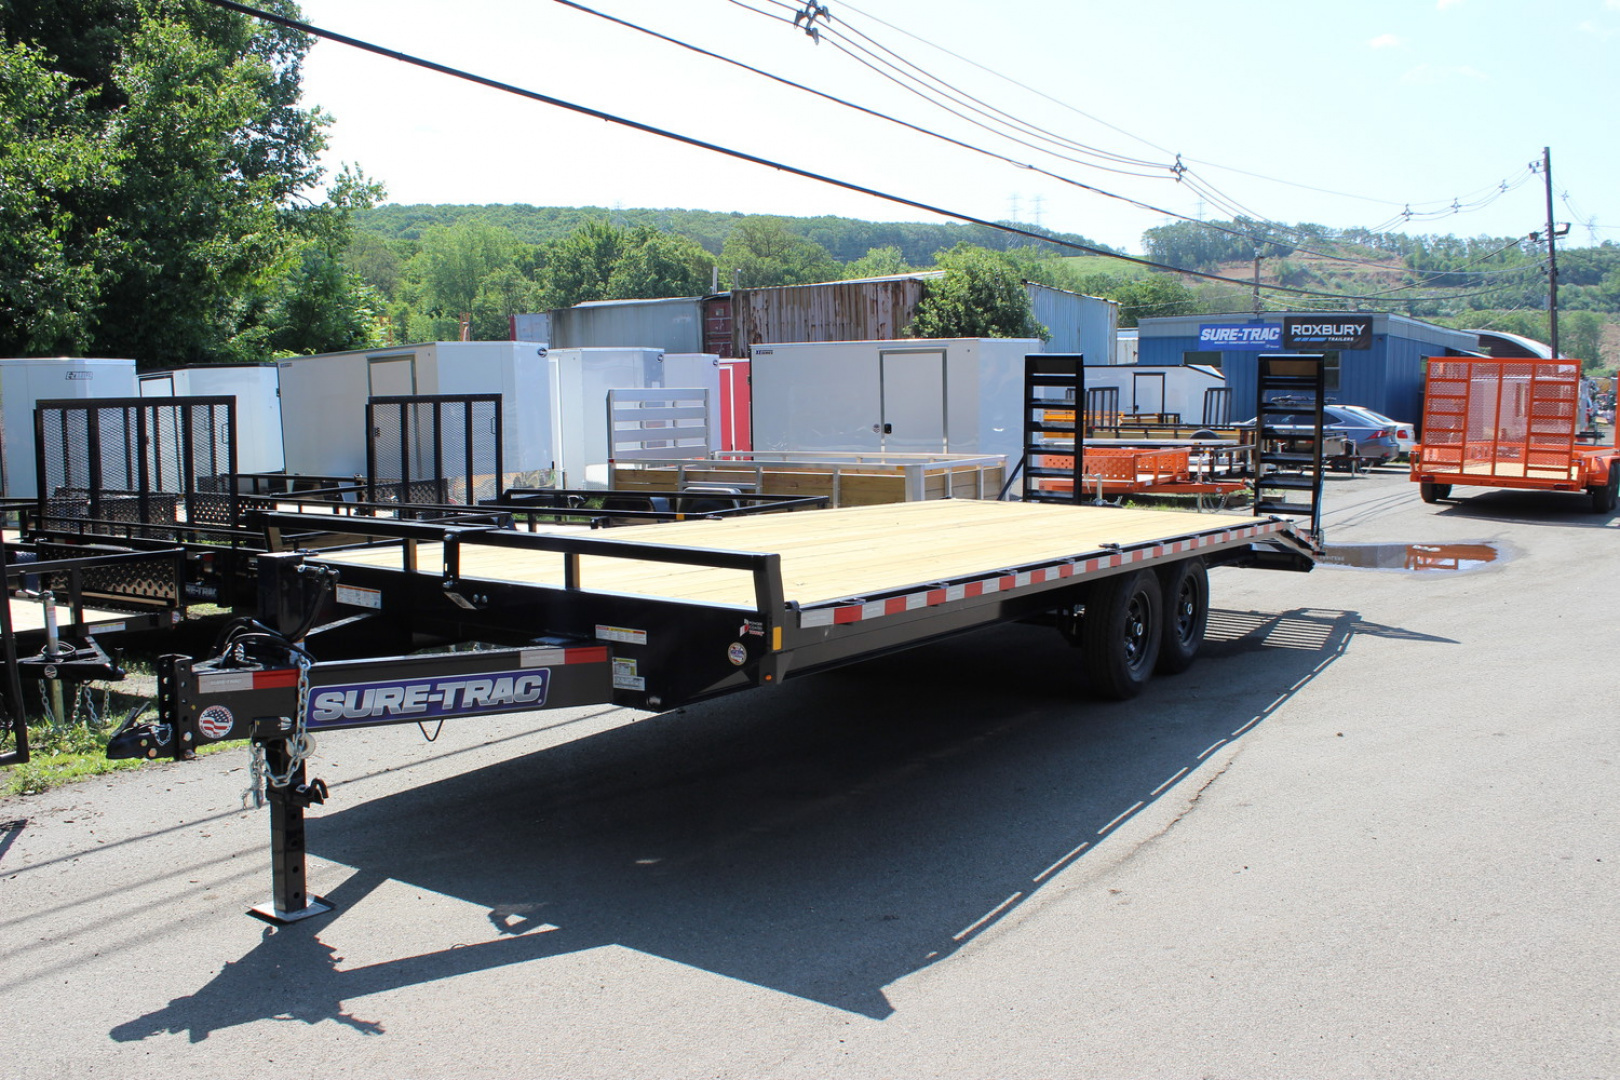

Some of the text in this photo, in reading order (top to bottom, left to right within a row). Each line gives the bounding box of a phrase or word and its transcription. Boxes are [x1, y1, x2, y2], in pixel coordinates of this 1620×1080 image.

[1200, 327, 1280, 341] SURE-TRAC
[1291, 324, 1366, 336] ROXBURY
[312, 674, 543, 722] SURE-TRAC
